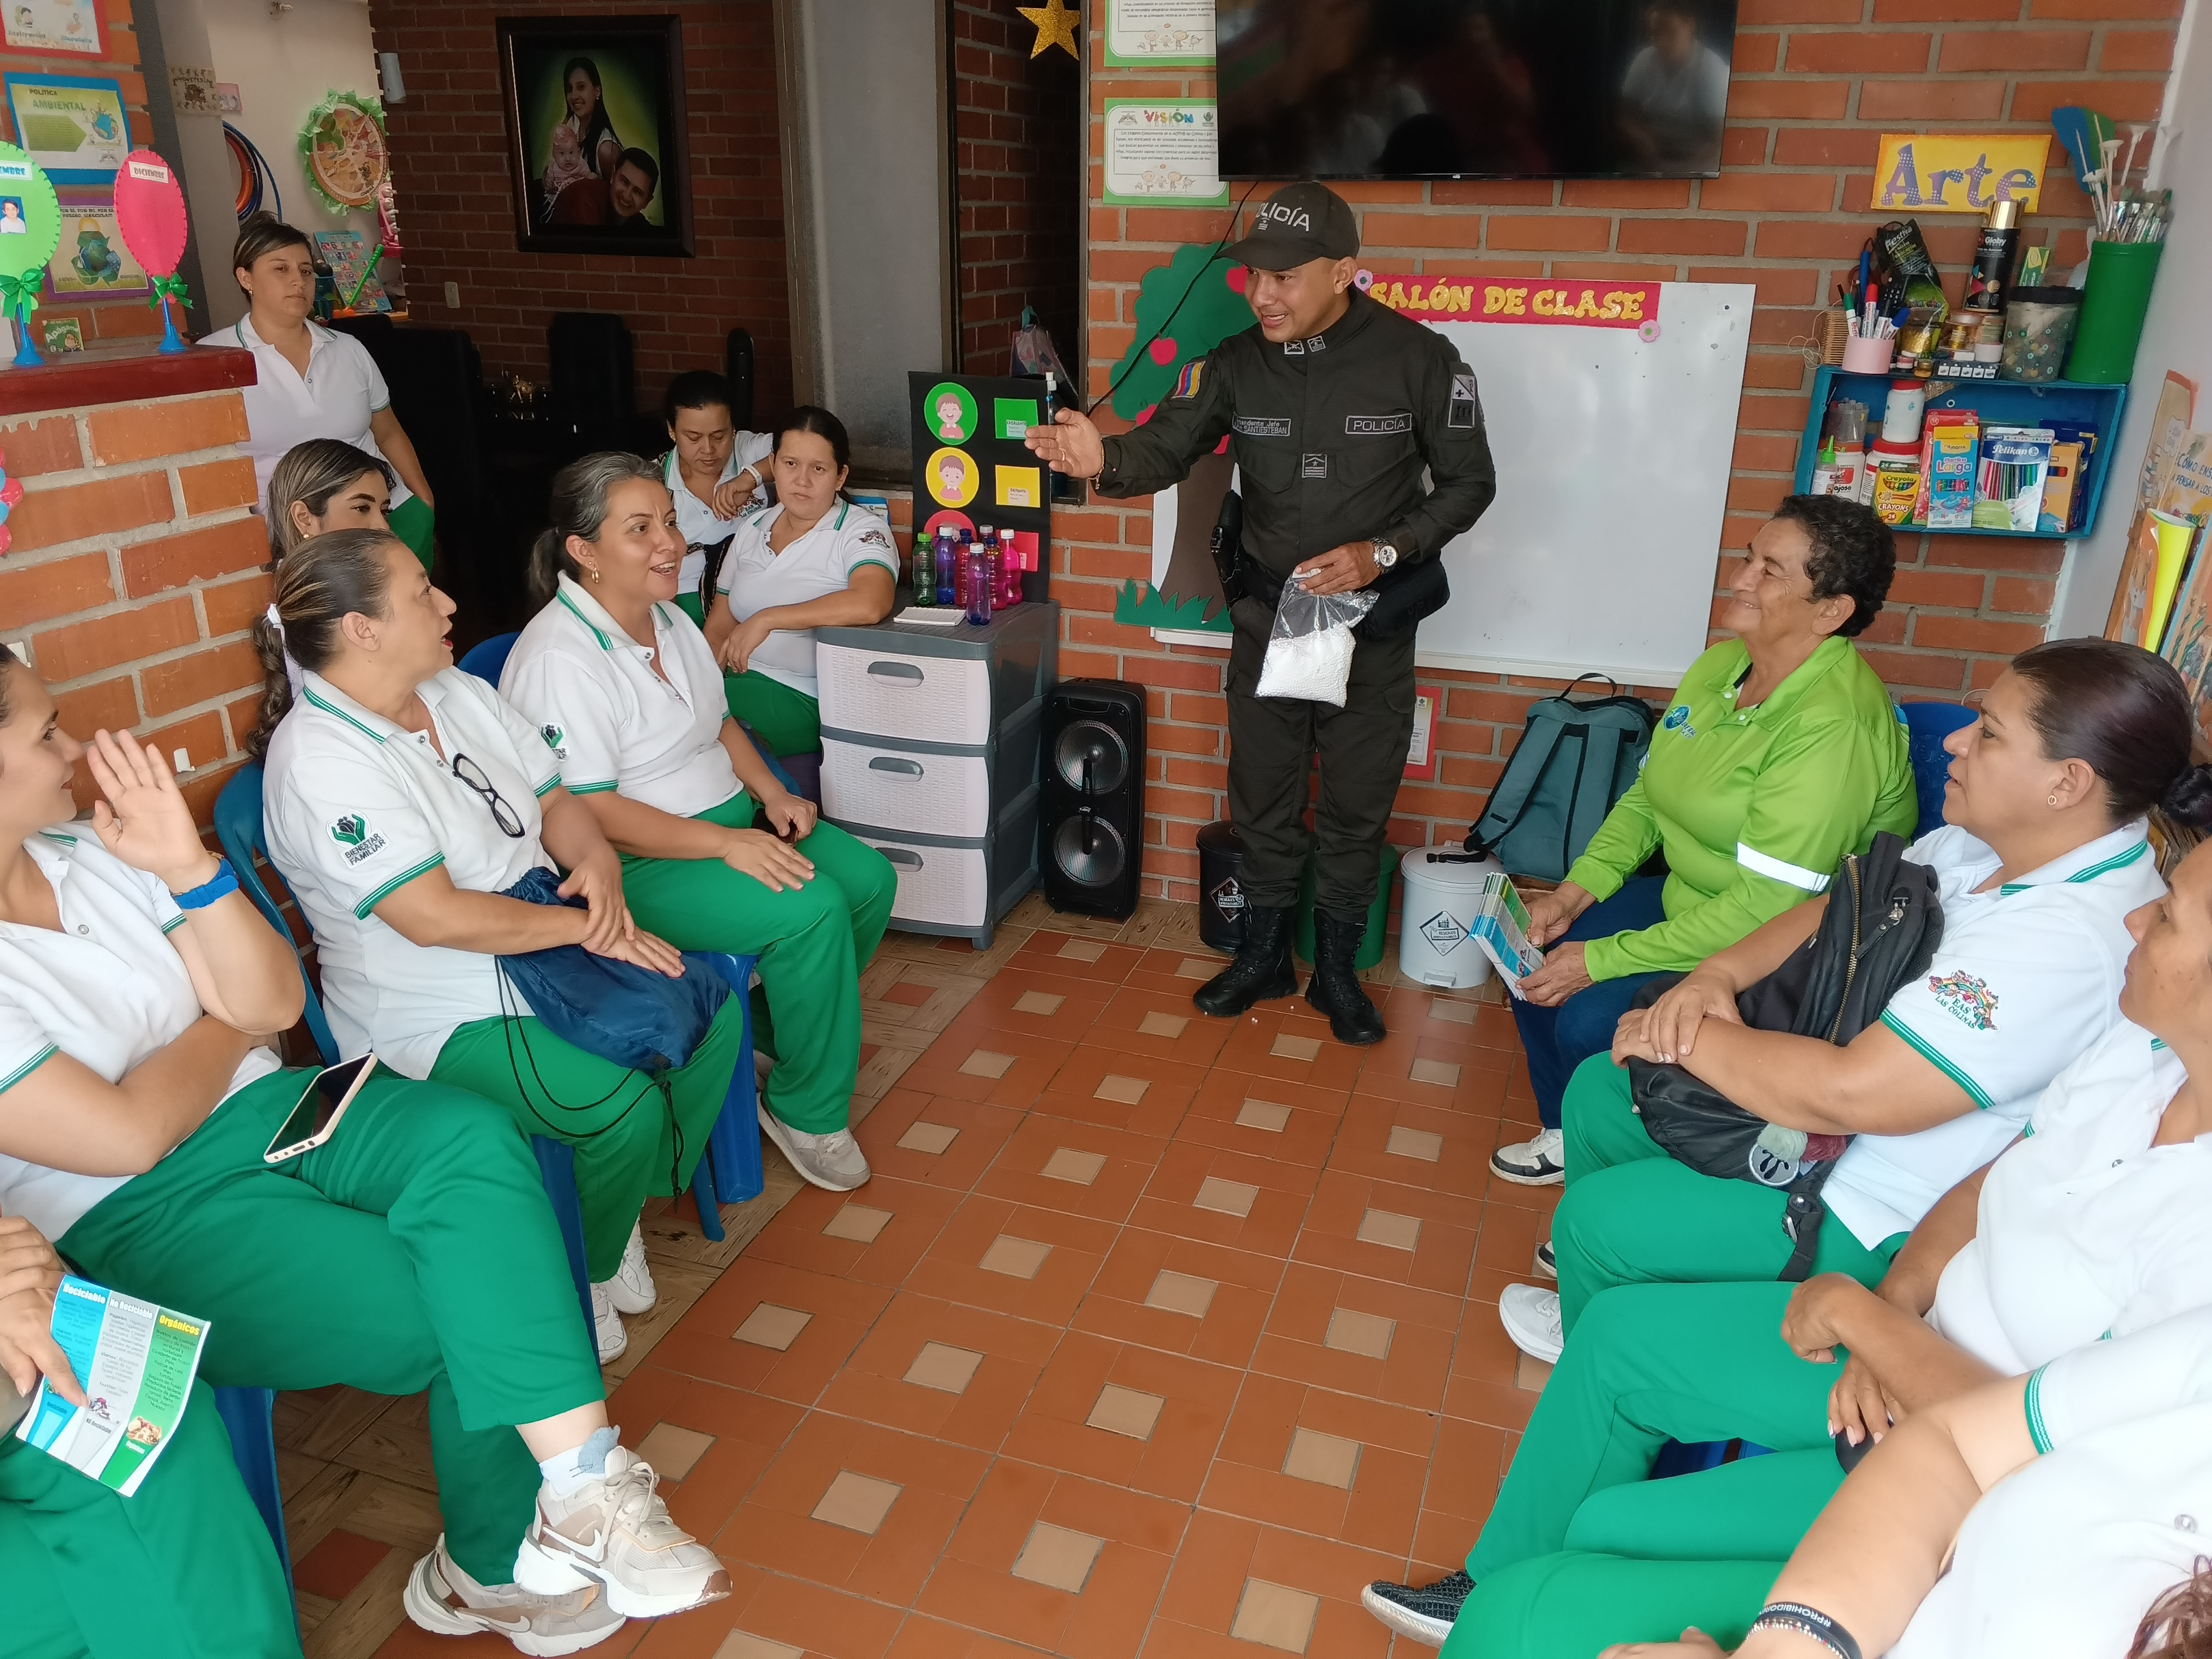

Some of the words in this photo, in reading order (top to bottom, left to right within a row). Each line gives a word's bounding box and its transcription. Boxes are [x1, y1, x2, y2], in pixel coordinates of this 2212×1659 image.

[133, 167, 164, 179] DICIEMBRE
[1881, 143, 2037, 207] Arte
[1985, 237, 2007, 246] Globy
[1369, 278, 1474, 312] SALÓN
[1482, 286, 1528, 315] DE
[1532, 289, 1646, 320] CLASE
[1244, 426, 1287, 434] SANTIESTEBAN
[1354, 417, 1405, 431] POLICÍA
[1992, 445, 2027, 455] Pelikan
[1937, 462, 1972, 474] Larga
[2199, 464, 2212, 479] ENS
[2176, 475, 2195, 489] PENSAR
[2199, 484, 2211, 495] LOS
[1878, 503, 1909, 512] CRAYONS
[345, 833, 380, 858] BIENESTAR
[349, 839, 386, 865] FAMILIAR
[1935, 995, 1948, 1007] LAS
[1948, 1006, 1976, 1028] COLINAS
[1952, 998, 1971, 1014] EAS
[63, 1283, 106, 1305] Reciclable
[108, 1298, 119, 1308] No
[118, 1300, 154, 1319] Reciclable
[158, 1314, 200, 1336] Orgánicos
